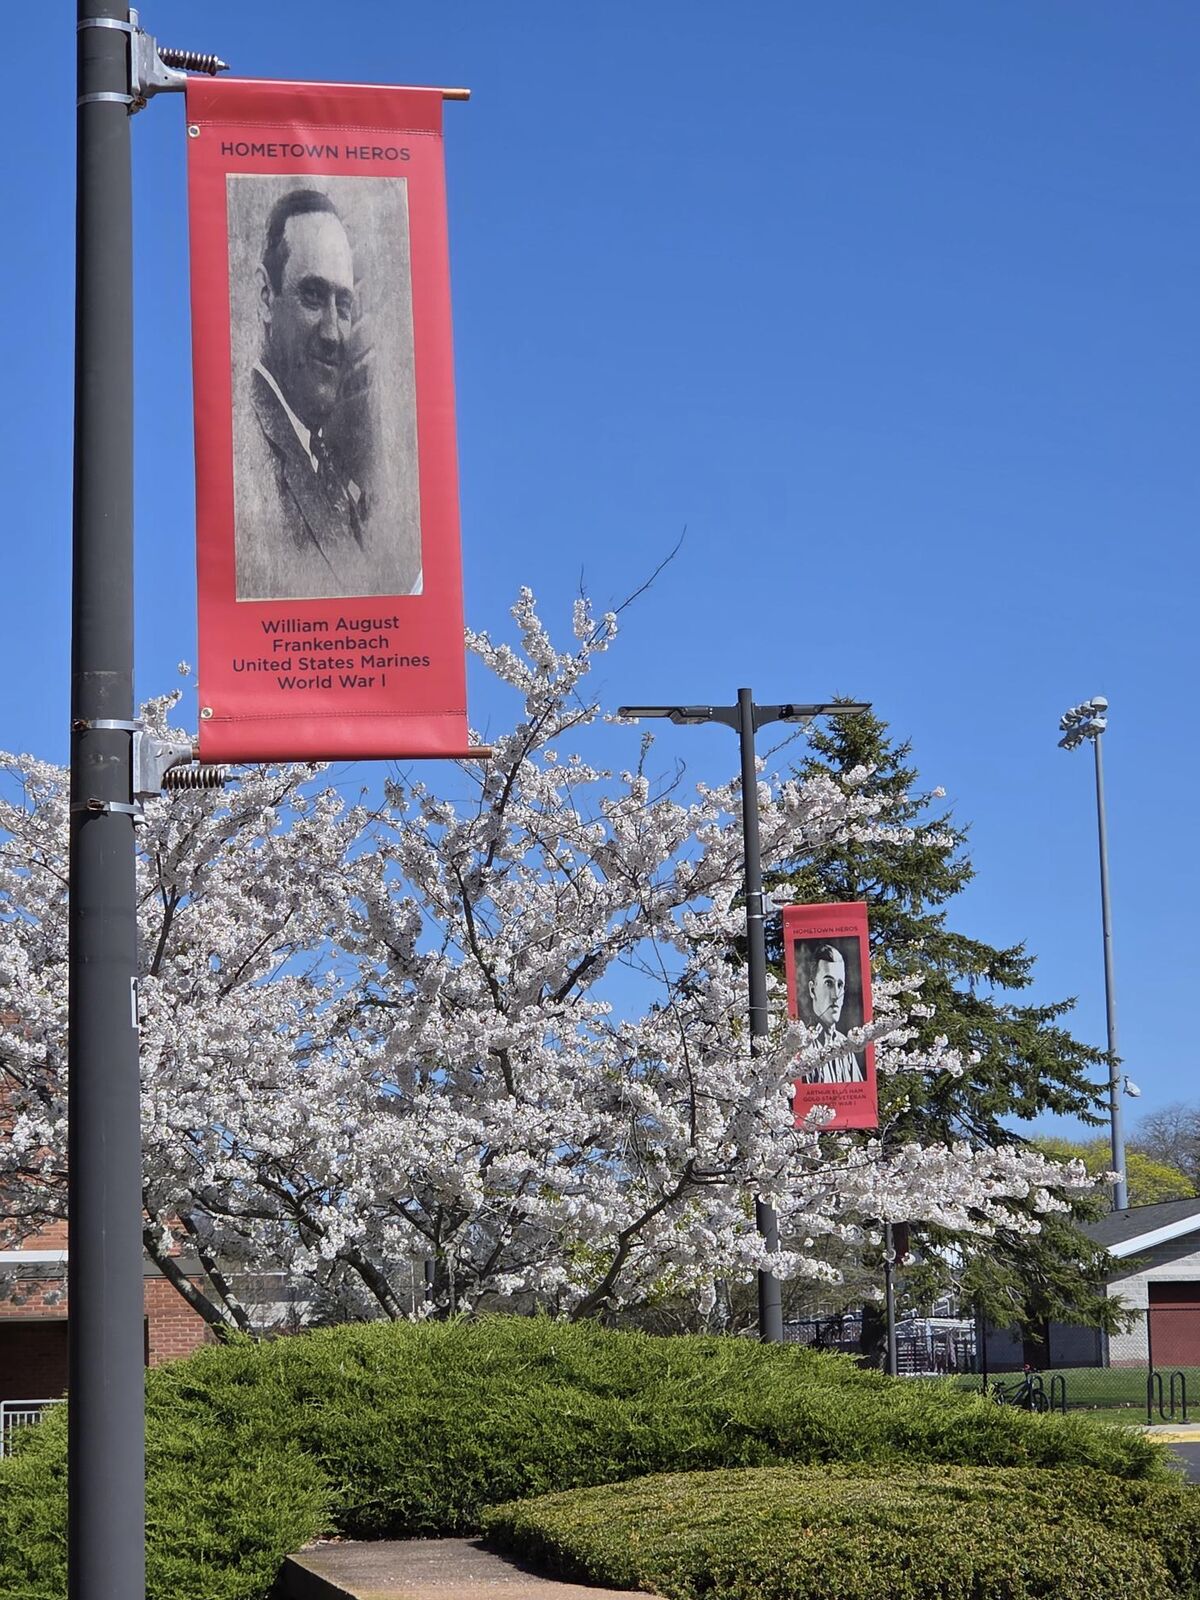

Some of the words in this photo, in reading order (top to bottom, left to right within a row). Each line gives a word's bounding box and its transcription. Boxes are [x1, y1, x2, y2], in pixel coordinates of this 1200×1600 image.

[221, 142, 339, 159] HOMETOWN
[345, 146, 411, 161] HEROS
[261, 619, 329, 634] William
[335, 616, 400, 633] August
[273, 635, 389, 652] Frankenbach
[232, 658, 292, 672] United
[298, 656, 354, 671] States
[361, 653, 431, 669] Marines
[277, 675, 332, 690] World
[338, 675, 375, 688] War
[381, 674, 386, 687] I
